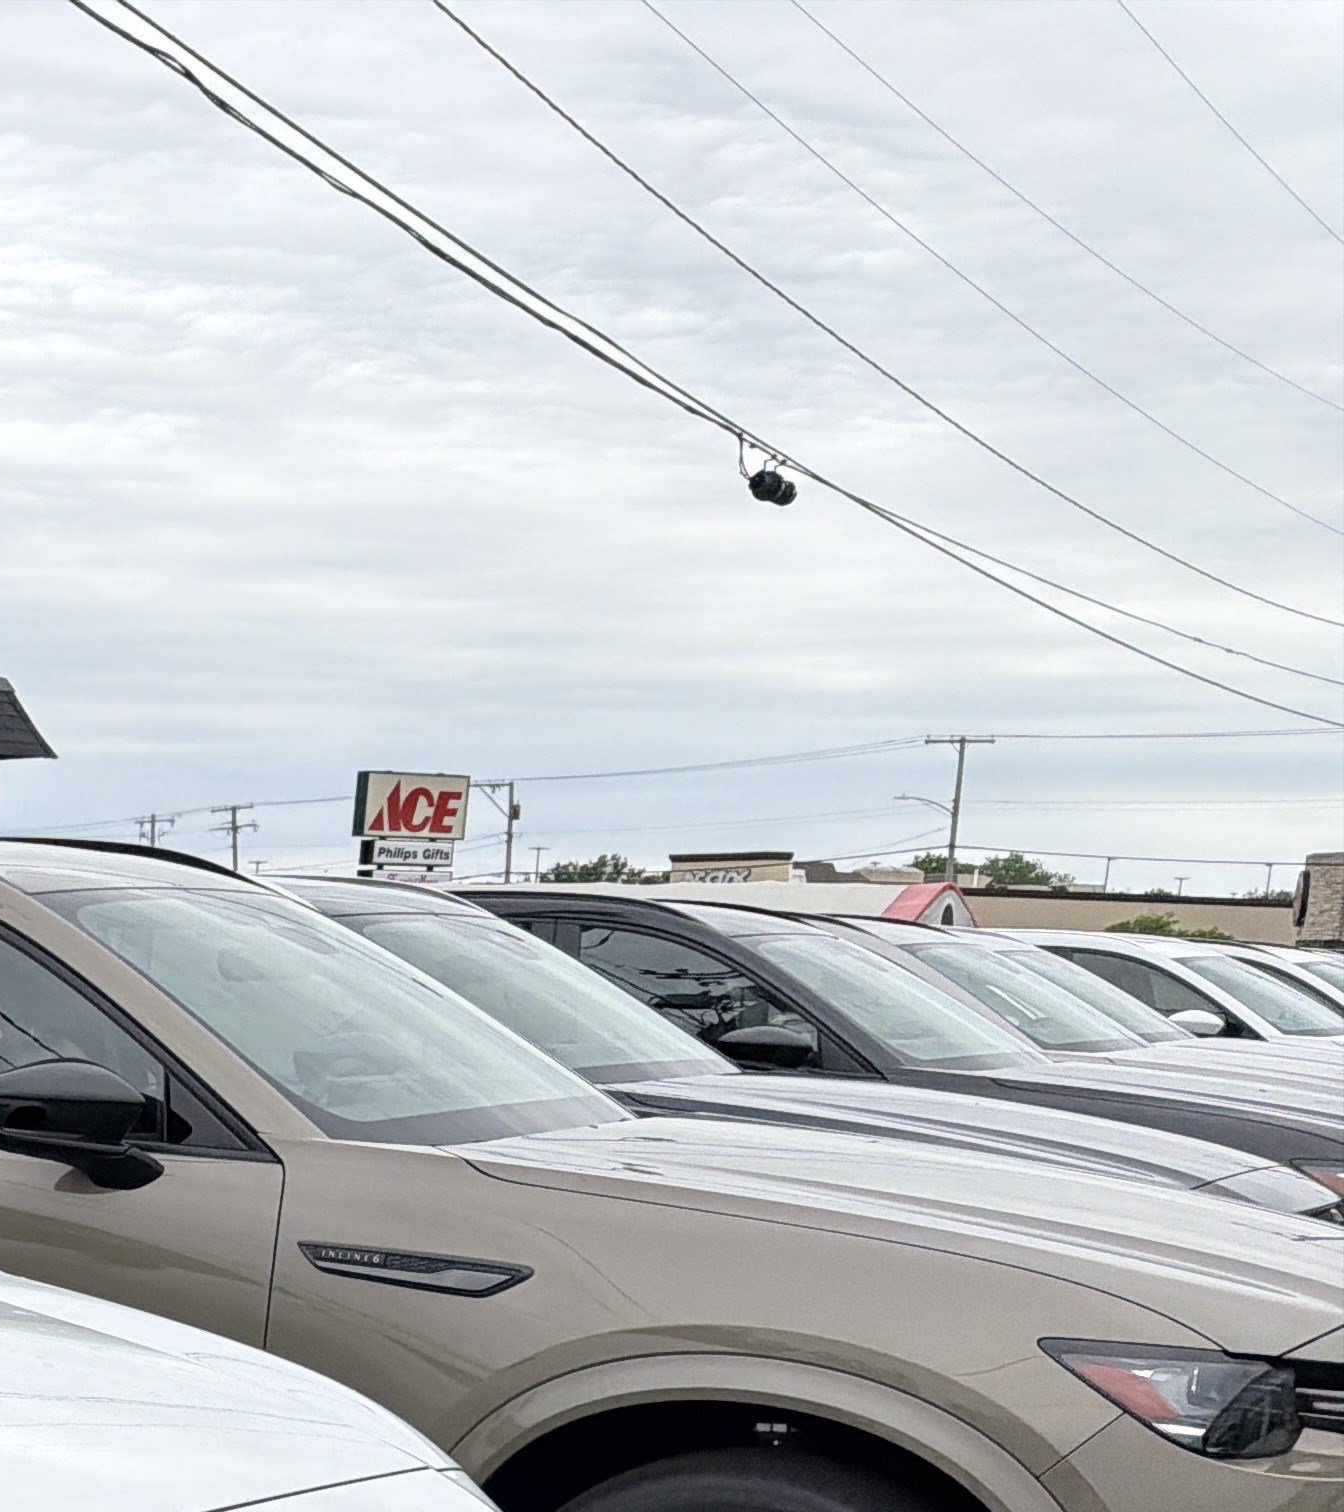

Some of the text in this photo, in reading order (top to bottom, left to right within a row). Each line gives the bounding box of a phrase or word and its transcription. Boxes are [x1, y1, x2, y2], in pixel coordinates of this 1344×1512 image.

[368, 779, 462, 833] ACE
[377, 846, 450, 861] Philips Gifts
[372, 1254, 380, 1263] 6
